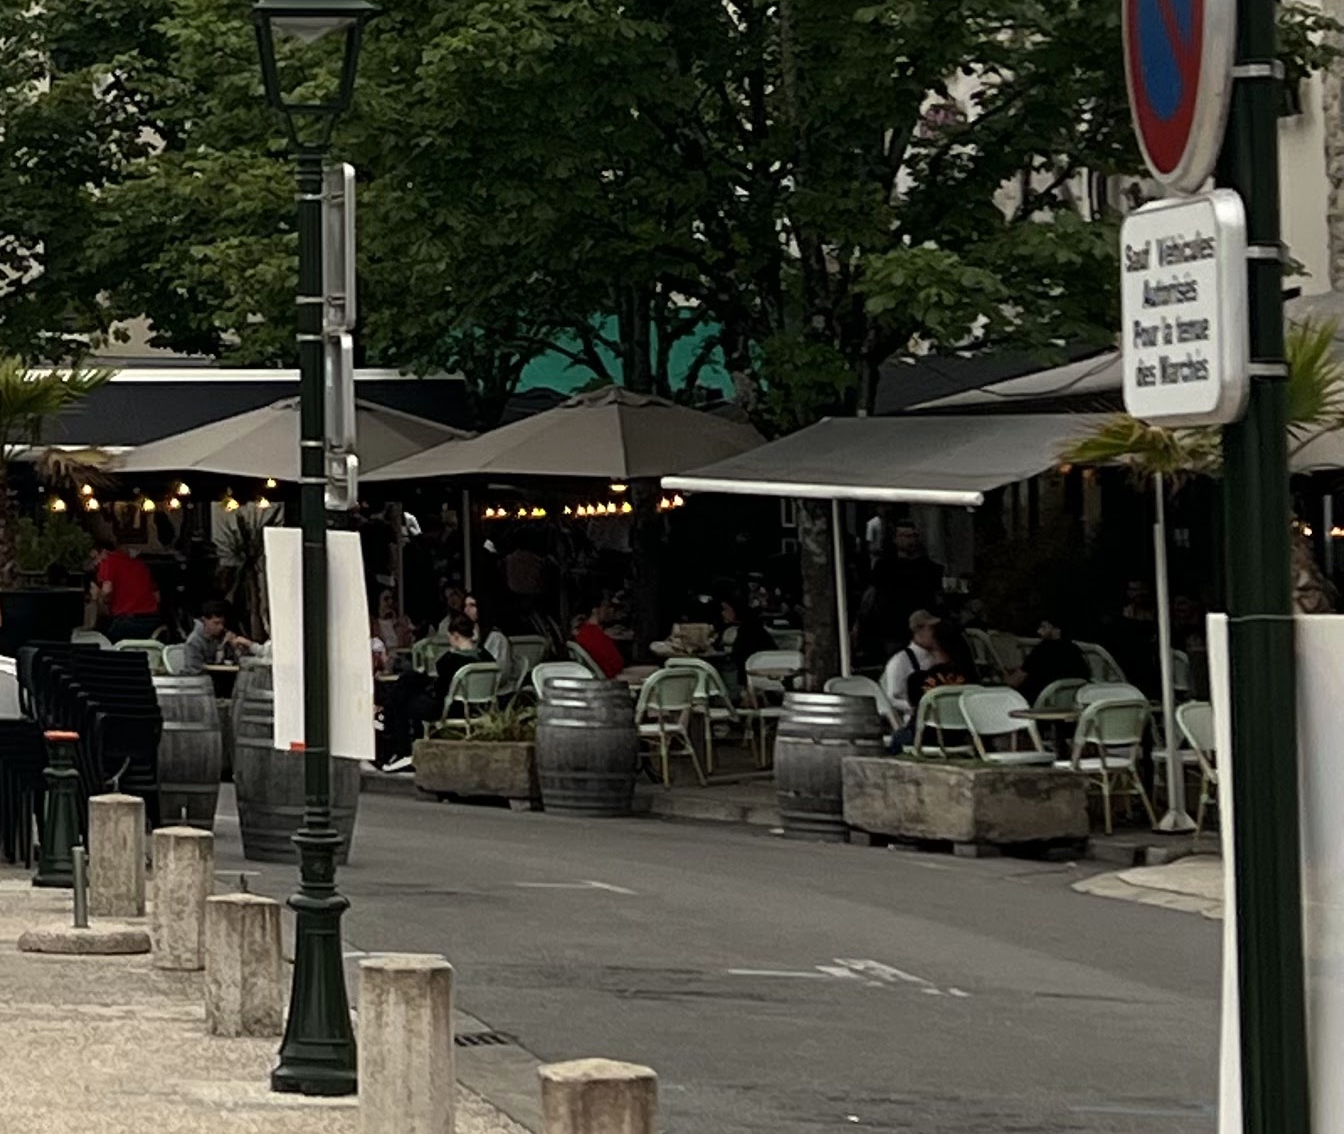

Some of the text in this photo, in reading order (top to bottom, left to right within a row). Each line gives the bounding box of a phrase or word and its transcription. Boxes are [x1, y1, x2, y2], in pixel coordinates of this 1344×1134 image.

[1125, 240, 1151, 272] Sauf
[1133, 320, 1159, 349] Pour
[1161, 315, 1173, 345] la
[1136, 357, 1156, 387] des
